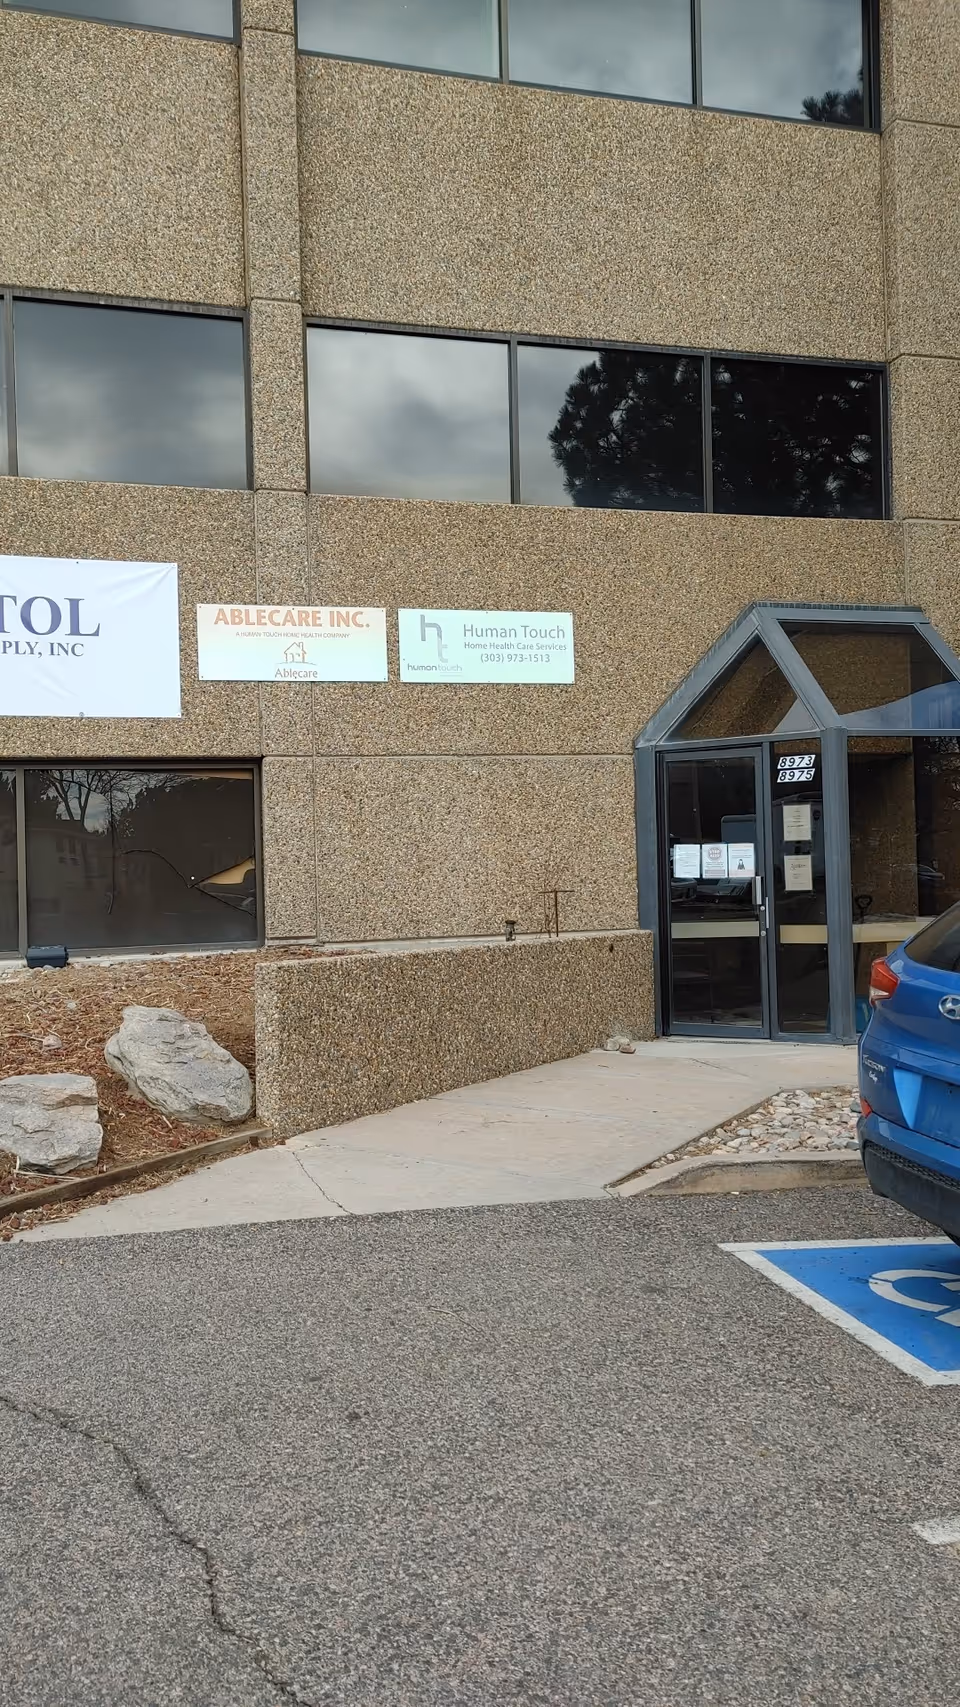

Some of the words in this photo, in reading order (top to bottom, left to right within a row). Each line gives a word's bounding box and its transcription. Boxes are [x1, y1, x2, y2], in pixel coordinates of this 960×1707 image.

[213, 607, 323, 628] ABLECARE
[328, 610, 370, 629] INC.
[322, 632, 351, 640] COMPANY
[463, 623, 518, 638] Human
[520, 625, 566, 639] Touch
[48, 641, 85, 657] INC
[464, 641, 488, 650] Home
[489, 641, 515, 650] Health
[516, 642, 534, 651] Care
[535, 642, 567, 651] Services
[480, 653, 505, 664] (303)
[506, 653, 551, 664] 973-1513
[275, 668, 318, 679] Ablecare
[779, 755, 813, 767] 8973
[779, 769, 813, 781] 8975
